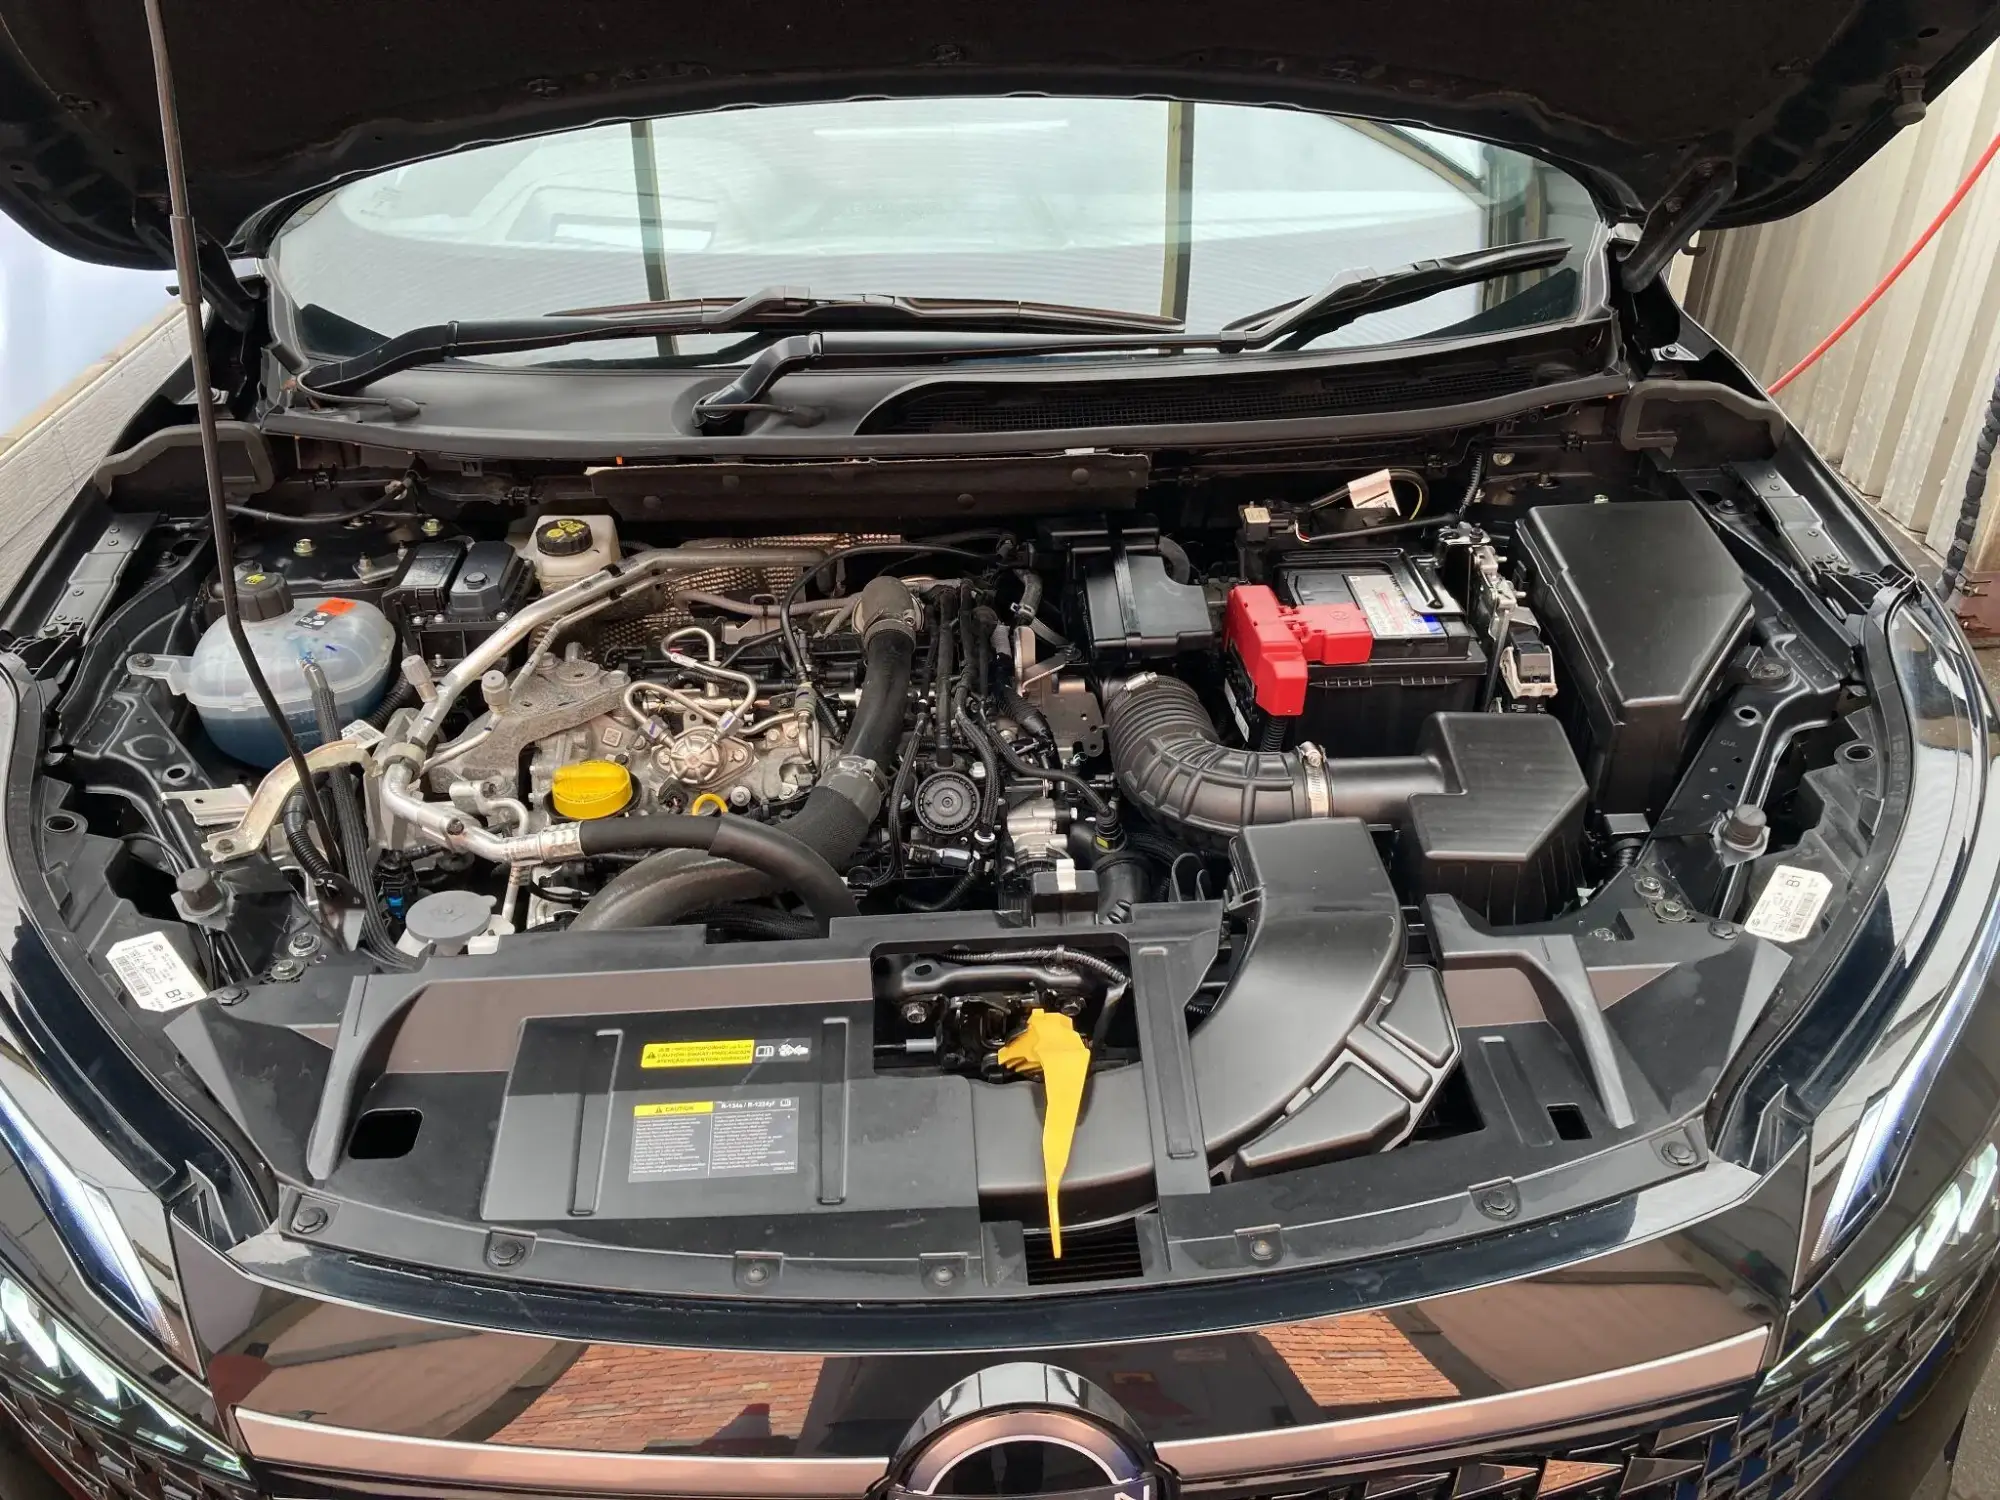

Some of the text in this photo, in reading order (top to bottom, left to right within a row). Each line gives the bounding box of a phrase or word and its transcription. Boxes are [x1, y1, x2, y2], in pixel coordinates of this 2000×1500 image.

[1786, 875, 1804, 887] B1
[165, 989, 186, 1003] B1
[665, 1104, 694, 1112] CAUTION
